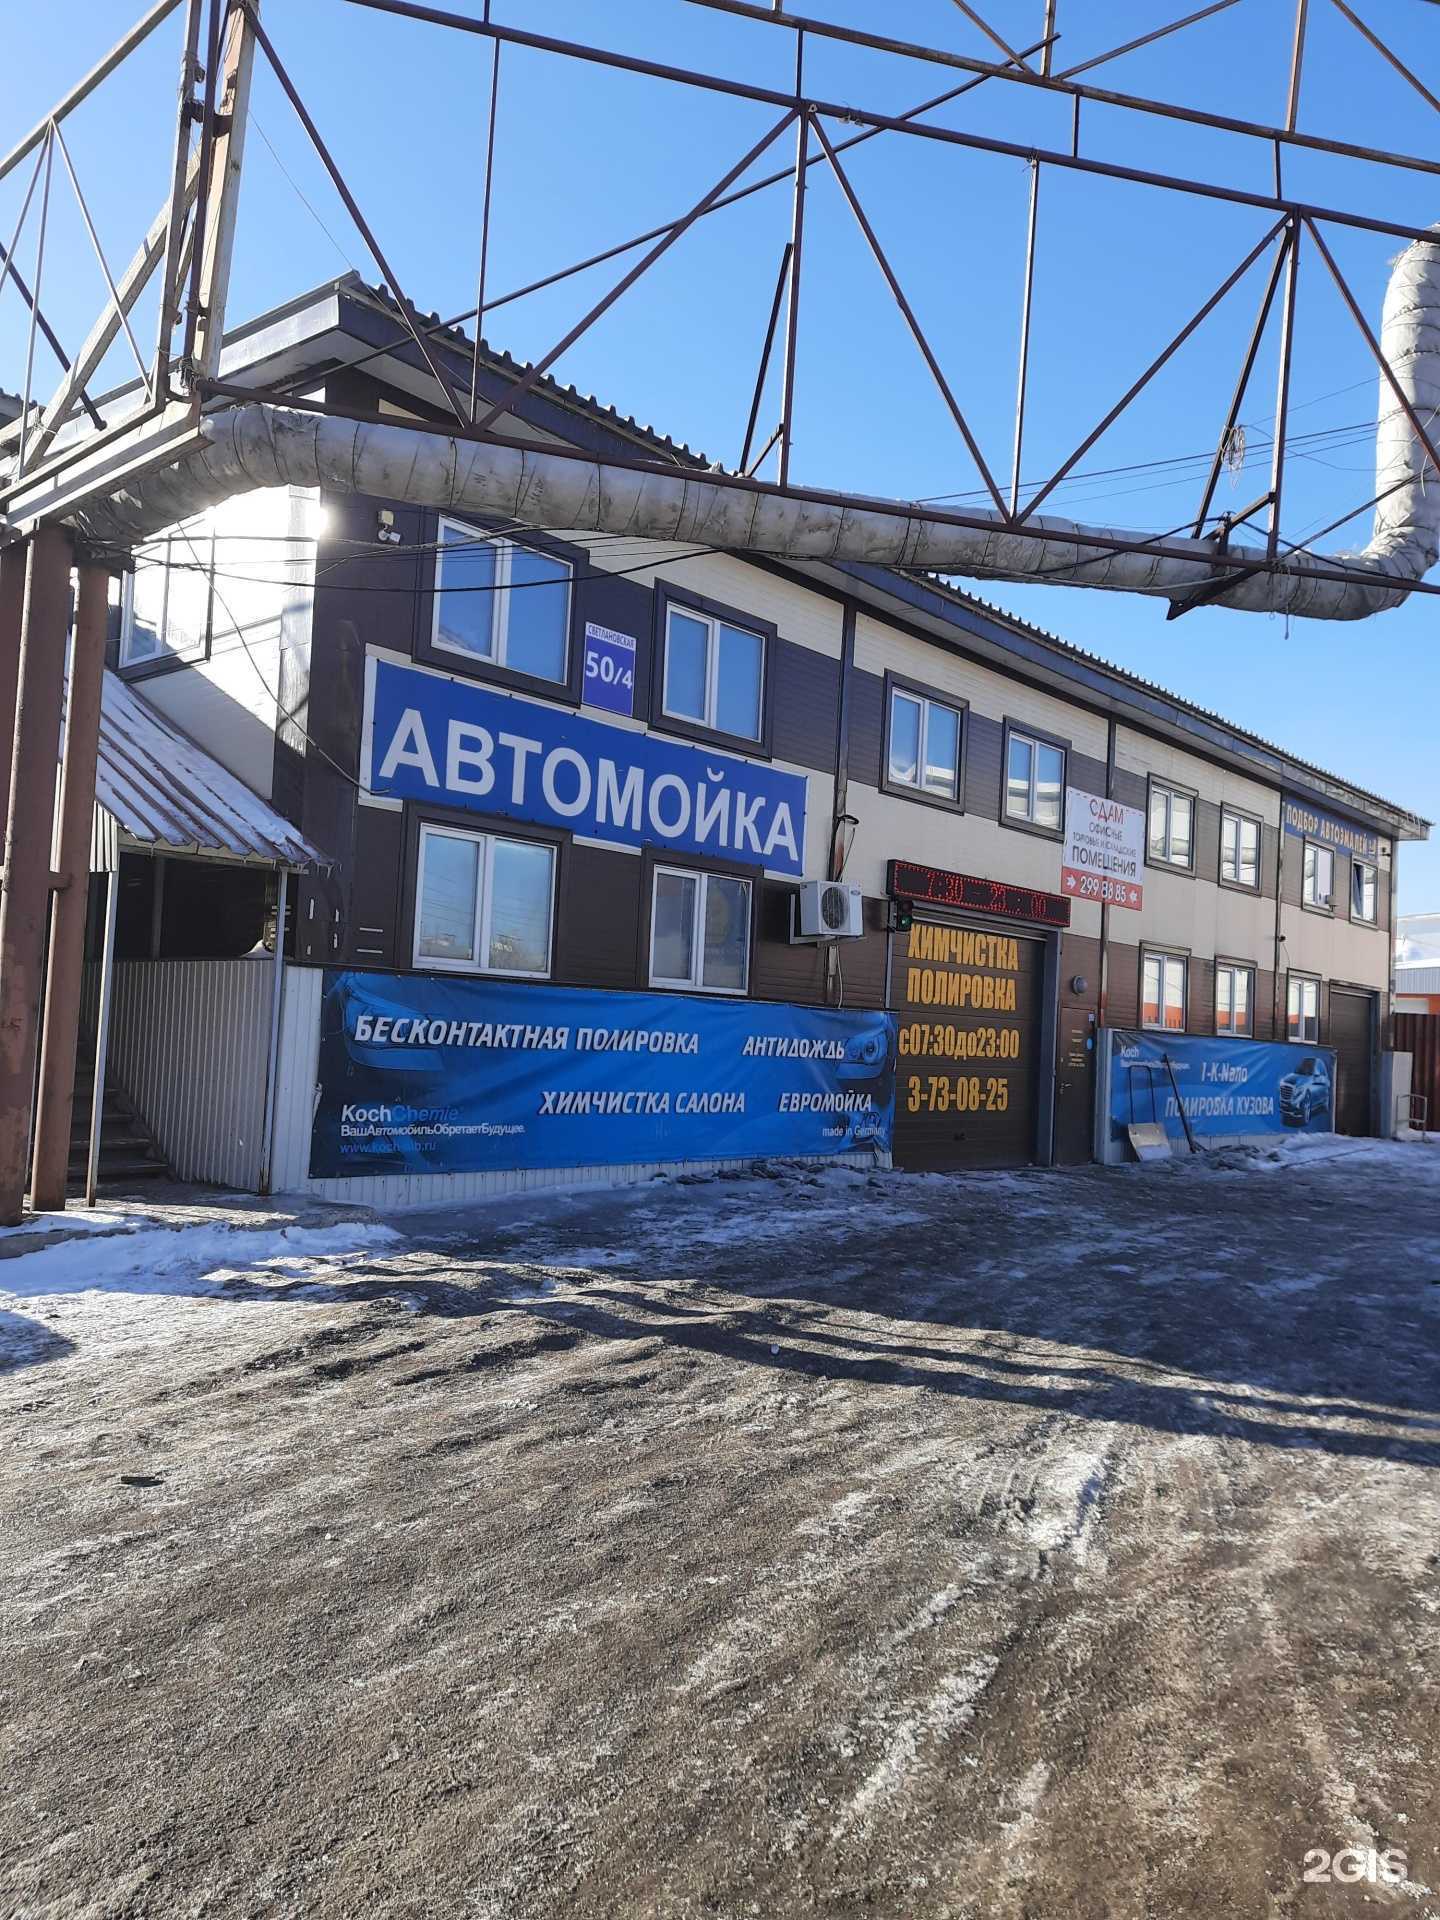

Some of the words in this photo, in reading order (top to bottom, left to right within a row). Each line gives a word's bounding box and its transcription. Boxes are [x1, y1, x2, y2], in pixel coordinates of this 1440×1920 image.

[588, 624, 634, 648] СВЕТЛАНОВСКАЯ
[585, 651, 633, 689] 50/4
[378, 707, 799, 862] АВТОМОЙКА
[1089, 799, 1124, 825] СДАМ
[1286, 804, 1319, 834] ПОДБОР
[1072, 845, 1137, 878] ПОМЕЩЕНИЯ
[1079, 876, 1100, 897] 299
[1102, 881, 1114, 899] 88
[1115, 886, 1127, 902] 85
[908, 923, 1019, 971] ХИМЧИСТКА
[907, 967, 1016, 1010] ПОЛИРОВКА
[354, 1015, 569, 1050] БЕСКОНТАКТНАЯ
[576, 1028, 699, 1054] ПОЛИРОВКА
[743, 1036, 845, 1059] АНТИДОЖДЬ
[538, 1091, 671, 1115] ХИМЧИСТКА
[674, 1092, 745, 1113] САЛОНА
[779, 1090, 872, 1112] ЕВРОМОЙКА
[907, 1075, 1009, 1112] 3-73-08-25
[822, 1127, 844, 1137] made
